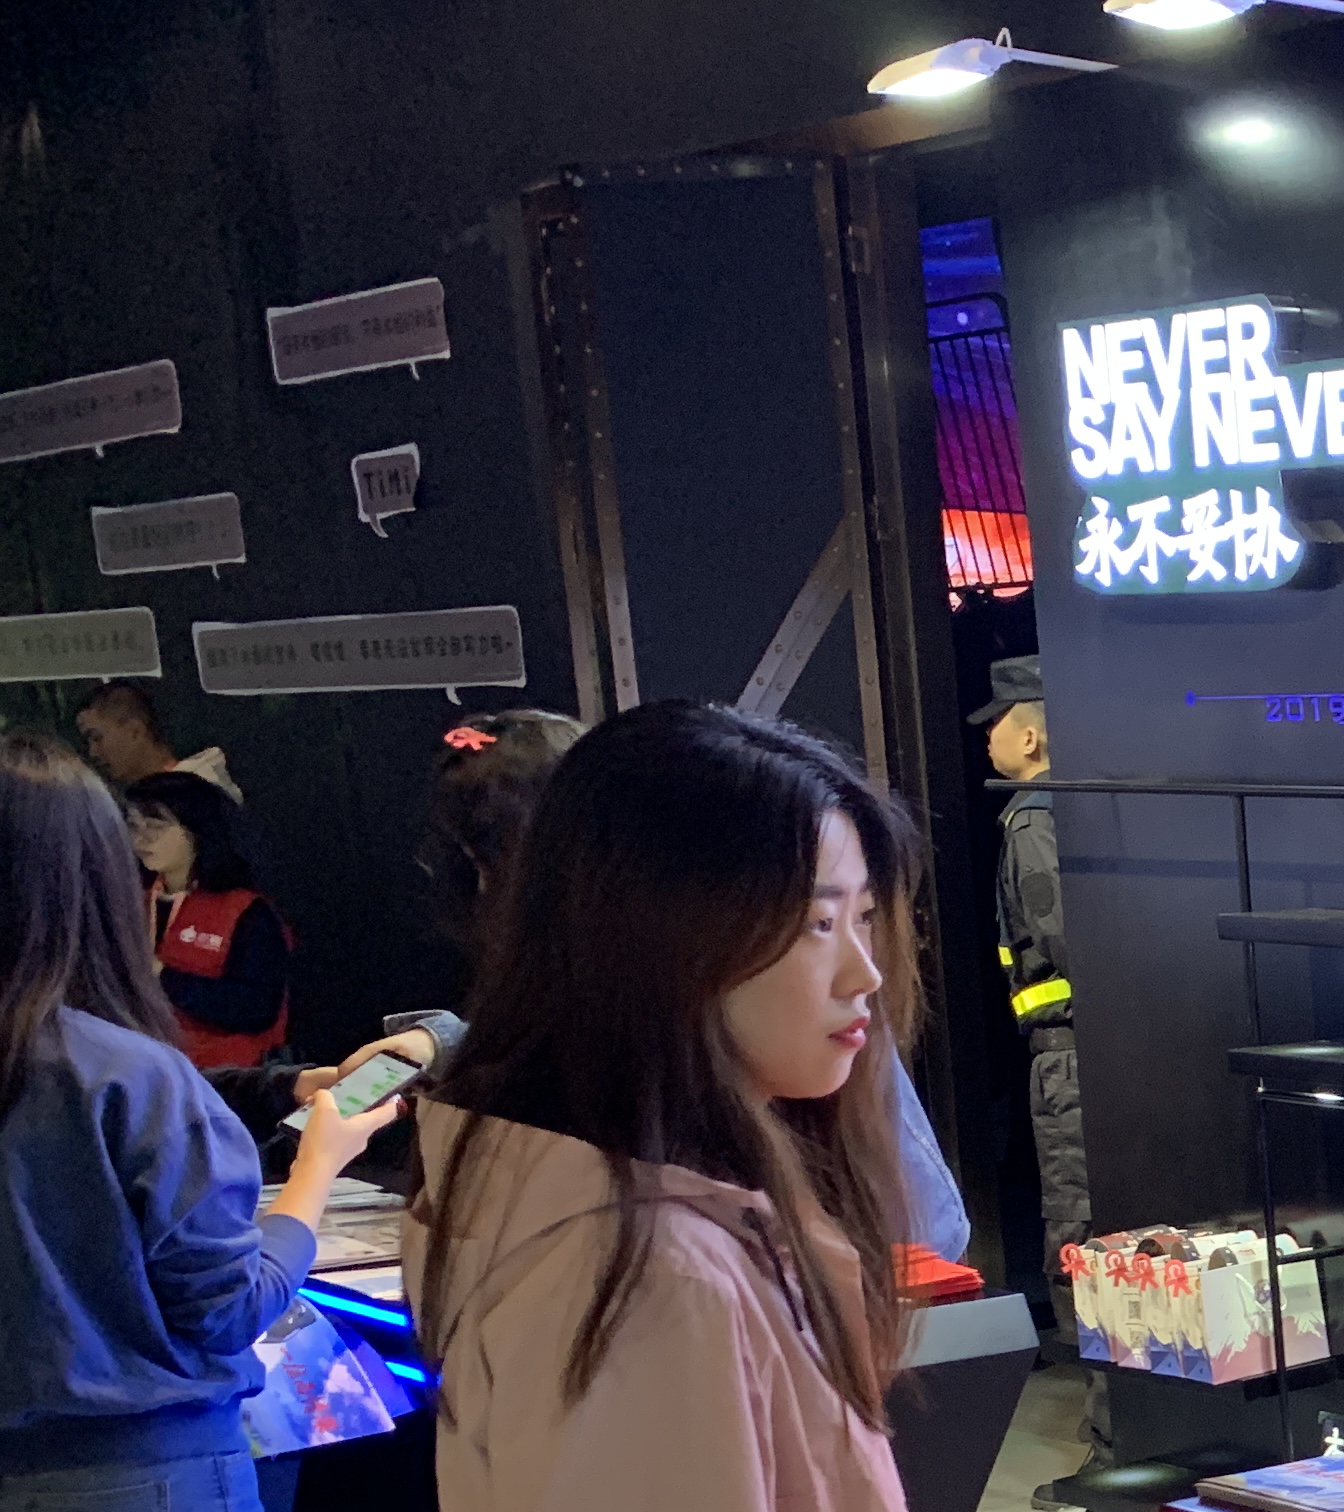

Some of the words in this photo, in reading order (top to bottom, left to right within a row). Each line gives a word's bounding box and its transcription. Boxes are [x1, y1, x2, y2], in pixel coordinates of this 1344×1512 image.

[1063, 304, 1275, 405] NEVER
[1070, 394, 1180, 480] SAY
[1075, 487, 1300, 588] 永不妥协
